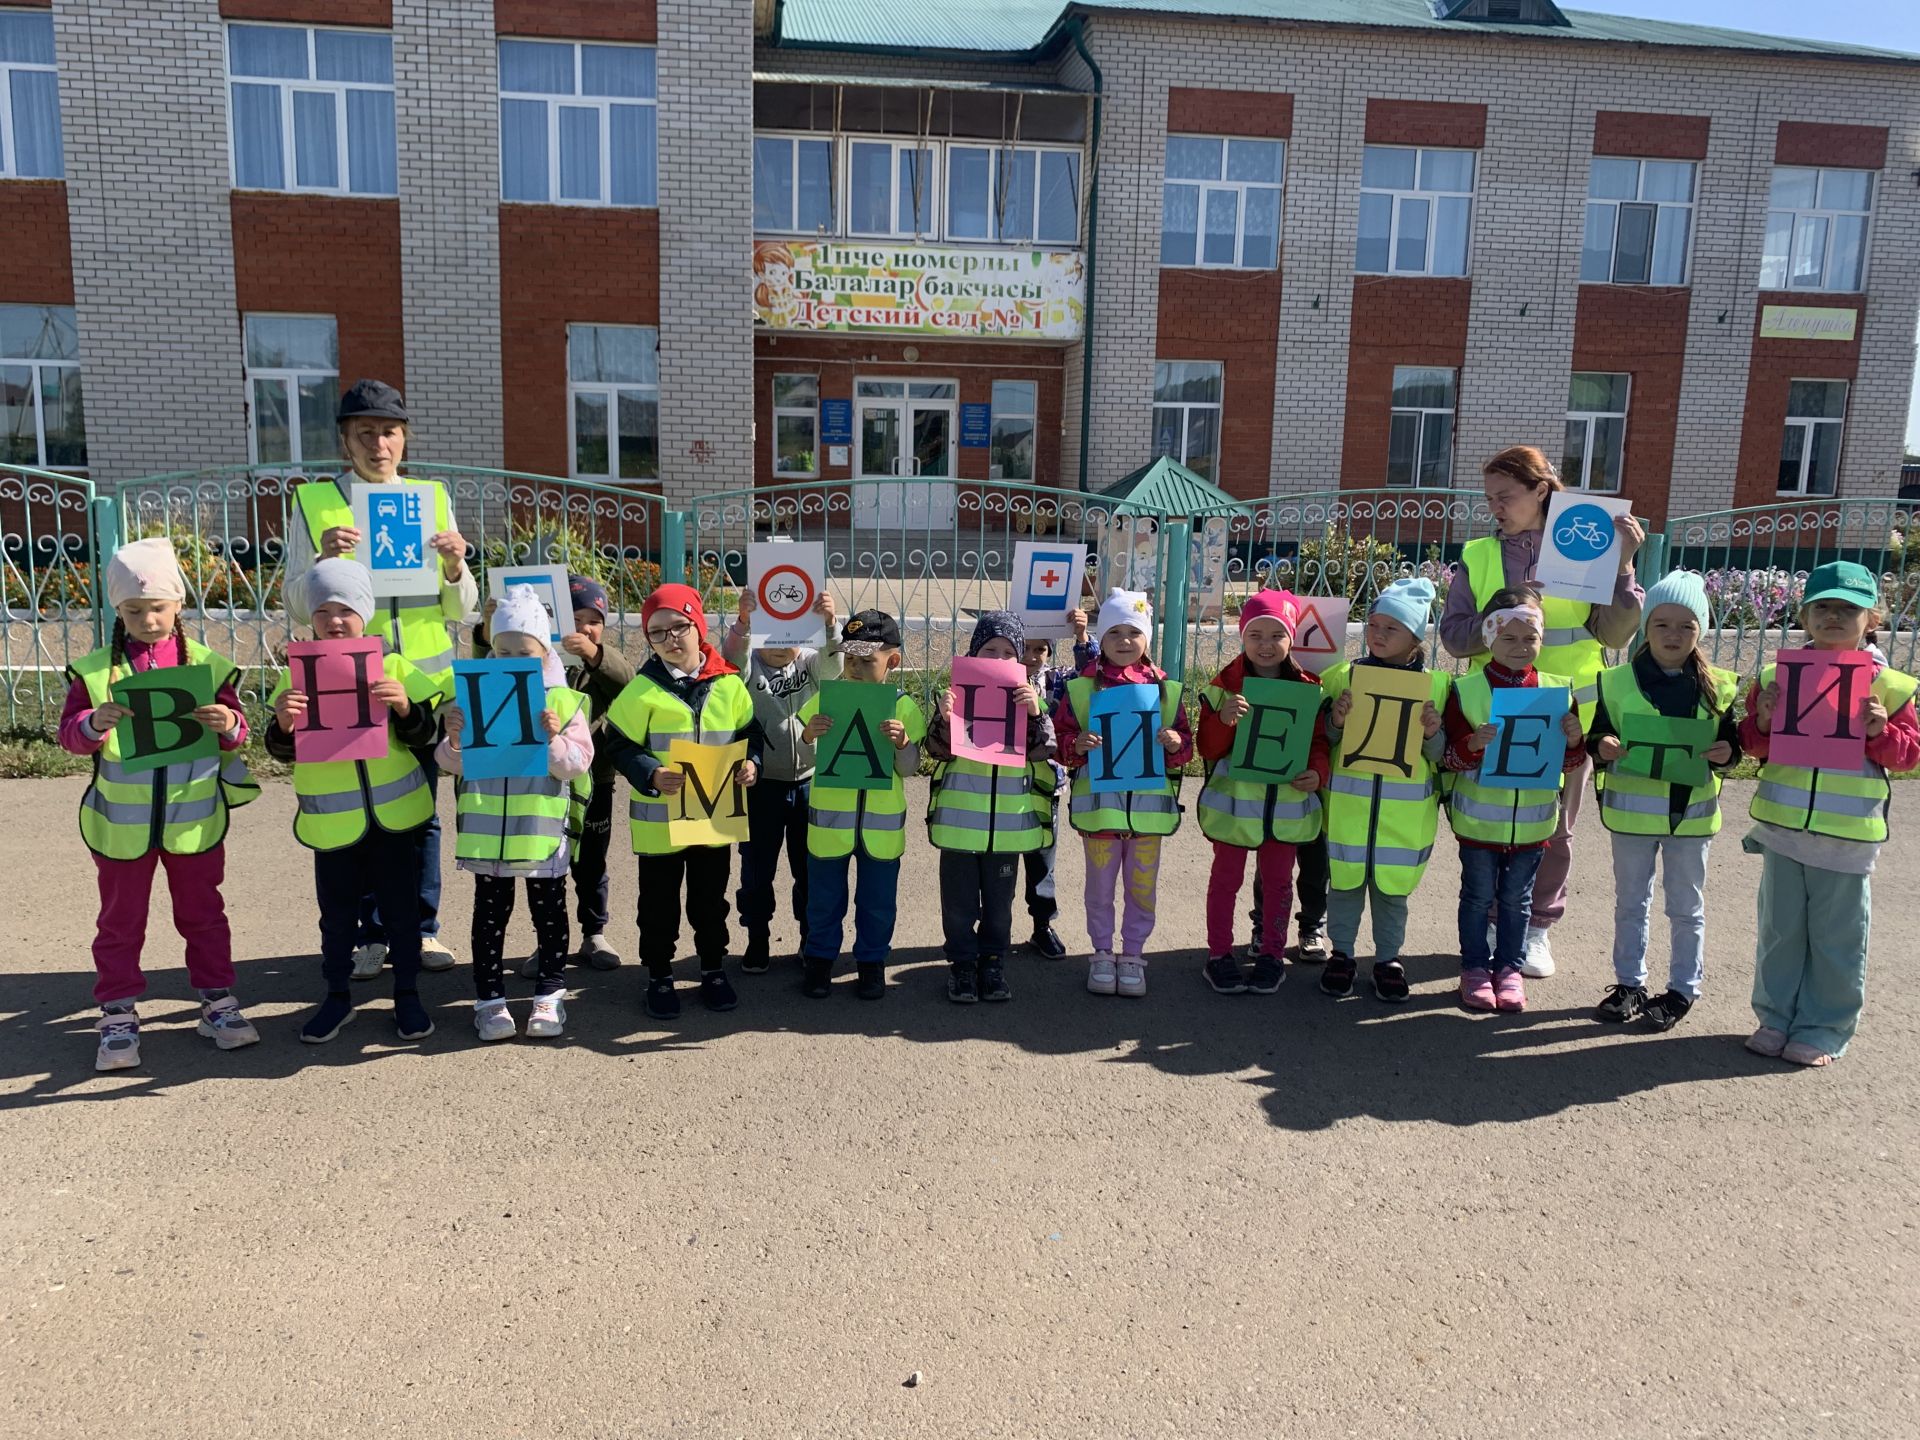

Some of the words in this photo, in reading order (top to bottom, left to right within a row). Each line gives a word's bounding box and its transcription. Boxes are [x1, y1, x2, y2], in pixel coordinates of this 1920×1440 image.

[794, 270, 914, 300] Балалар
[924, 275, 1042, 299] бакчасы
[894, 252, 1019, 275] номерлы
[791, 301, 920, 326] Детский
[930, 310, 978, 329] сад
[987, 308, 1020, 329] №
[1033, 310, 1042, 329] 1
[125, 687, 205, 761] В
[292, 651, 383, 732] Н
[455, 670, 545, 750] И
[956, 684, 1025, 756] Н
[1772, 661, 1866, 740] И
[819, 708, 893, 779] А
[1093, 710, 1160, 781] И
[1233, 704, 1297, 775] Е
[1342, 692, 1423, 777] Д
[1487, 714, 1551, 778] Е
[673, 759, 747, 821] М
